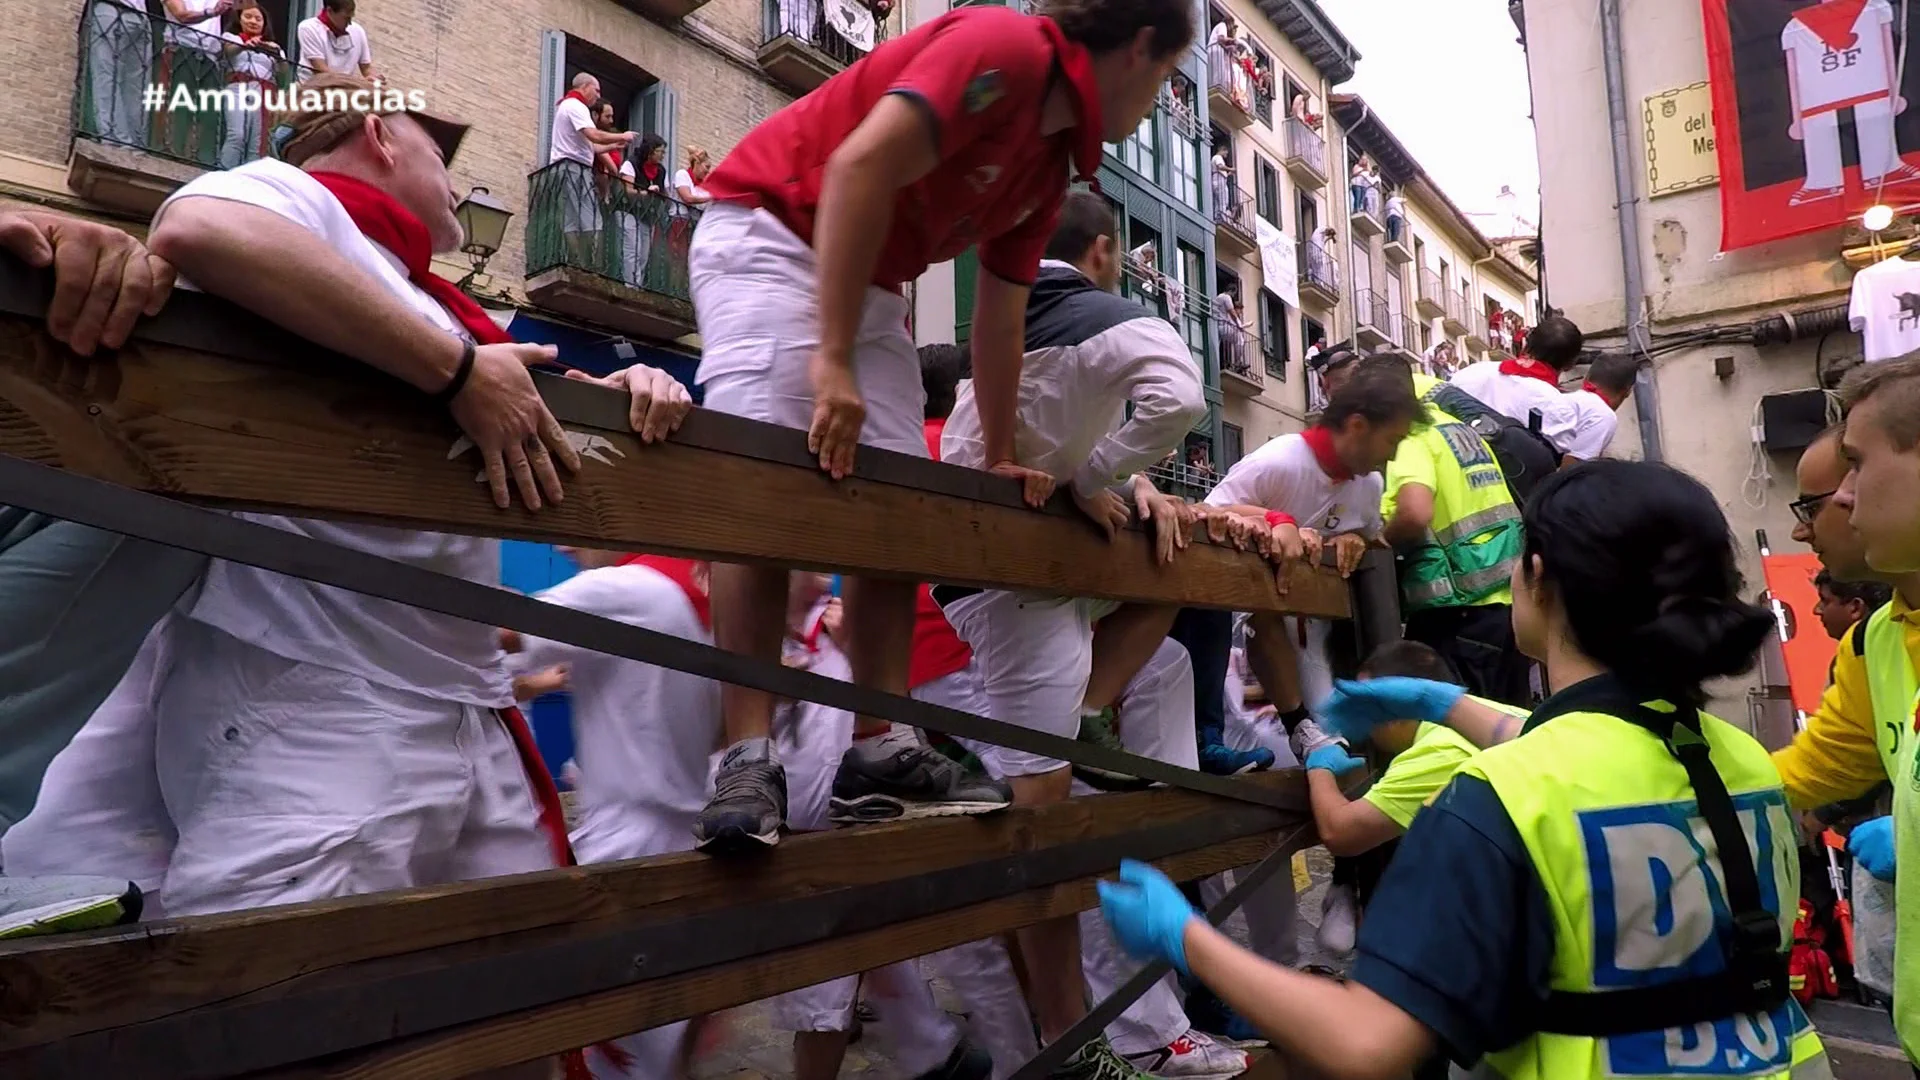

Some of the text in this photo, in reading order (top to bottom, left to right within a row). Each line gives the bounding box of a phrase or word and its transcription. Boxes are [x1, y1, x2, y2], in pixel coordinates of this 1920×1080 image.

[1821, 47, 1861, 73] SF
[1684, 112, 1706, 134] del
[1693, 136, 1715, 155] Me
